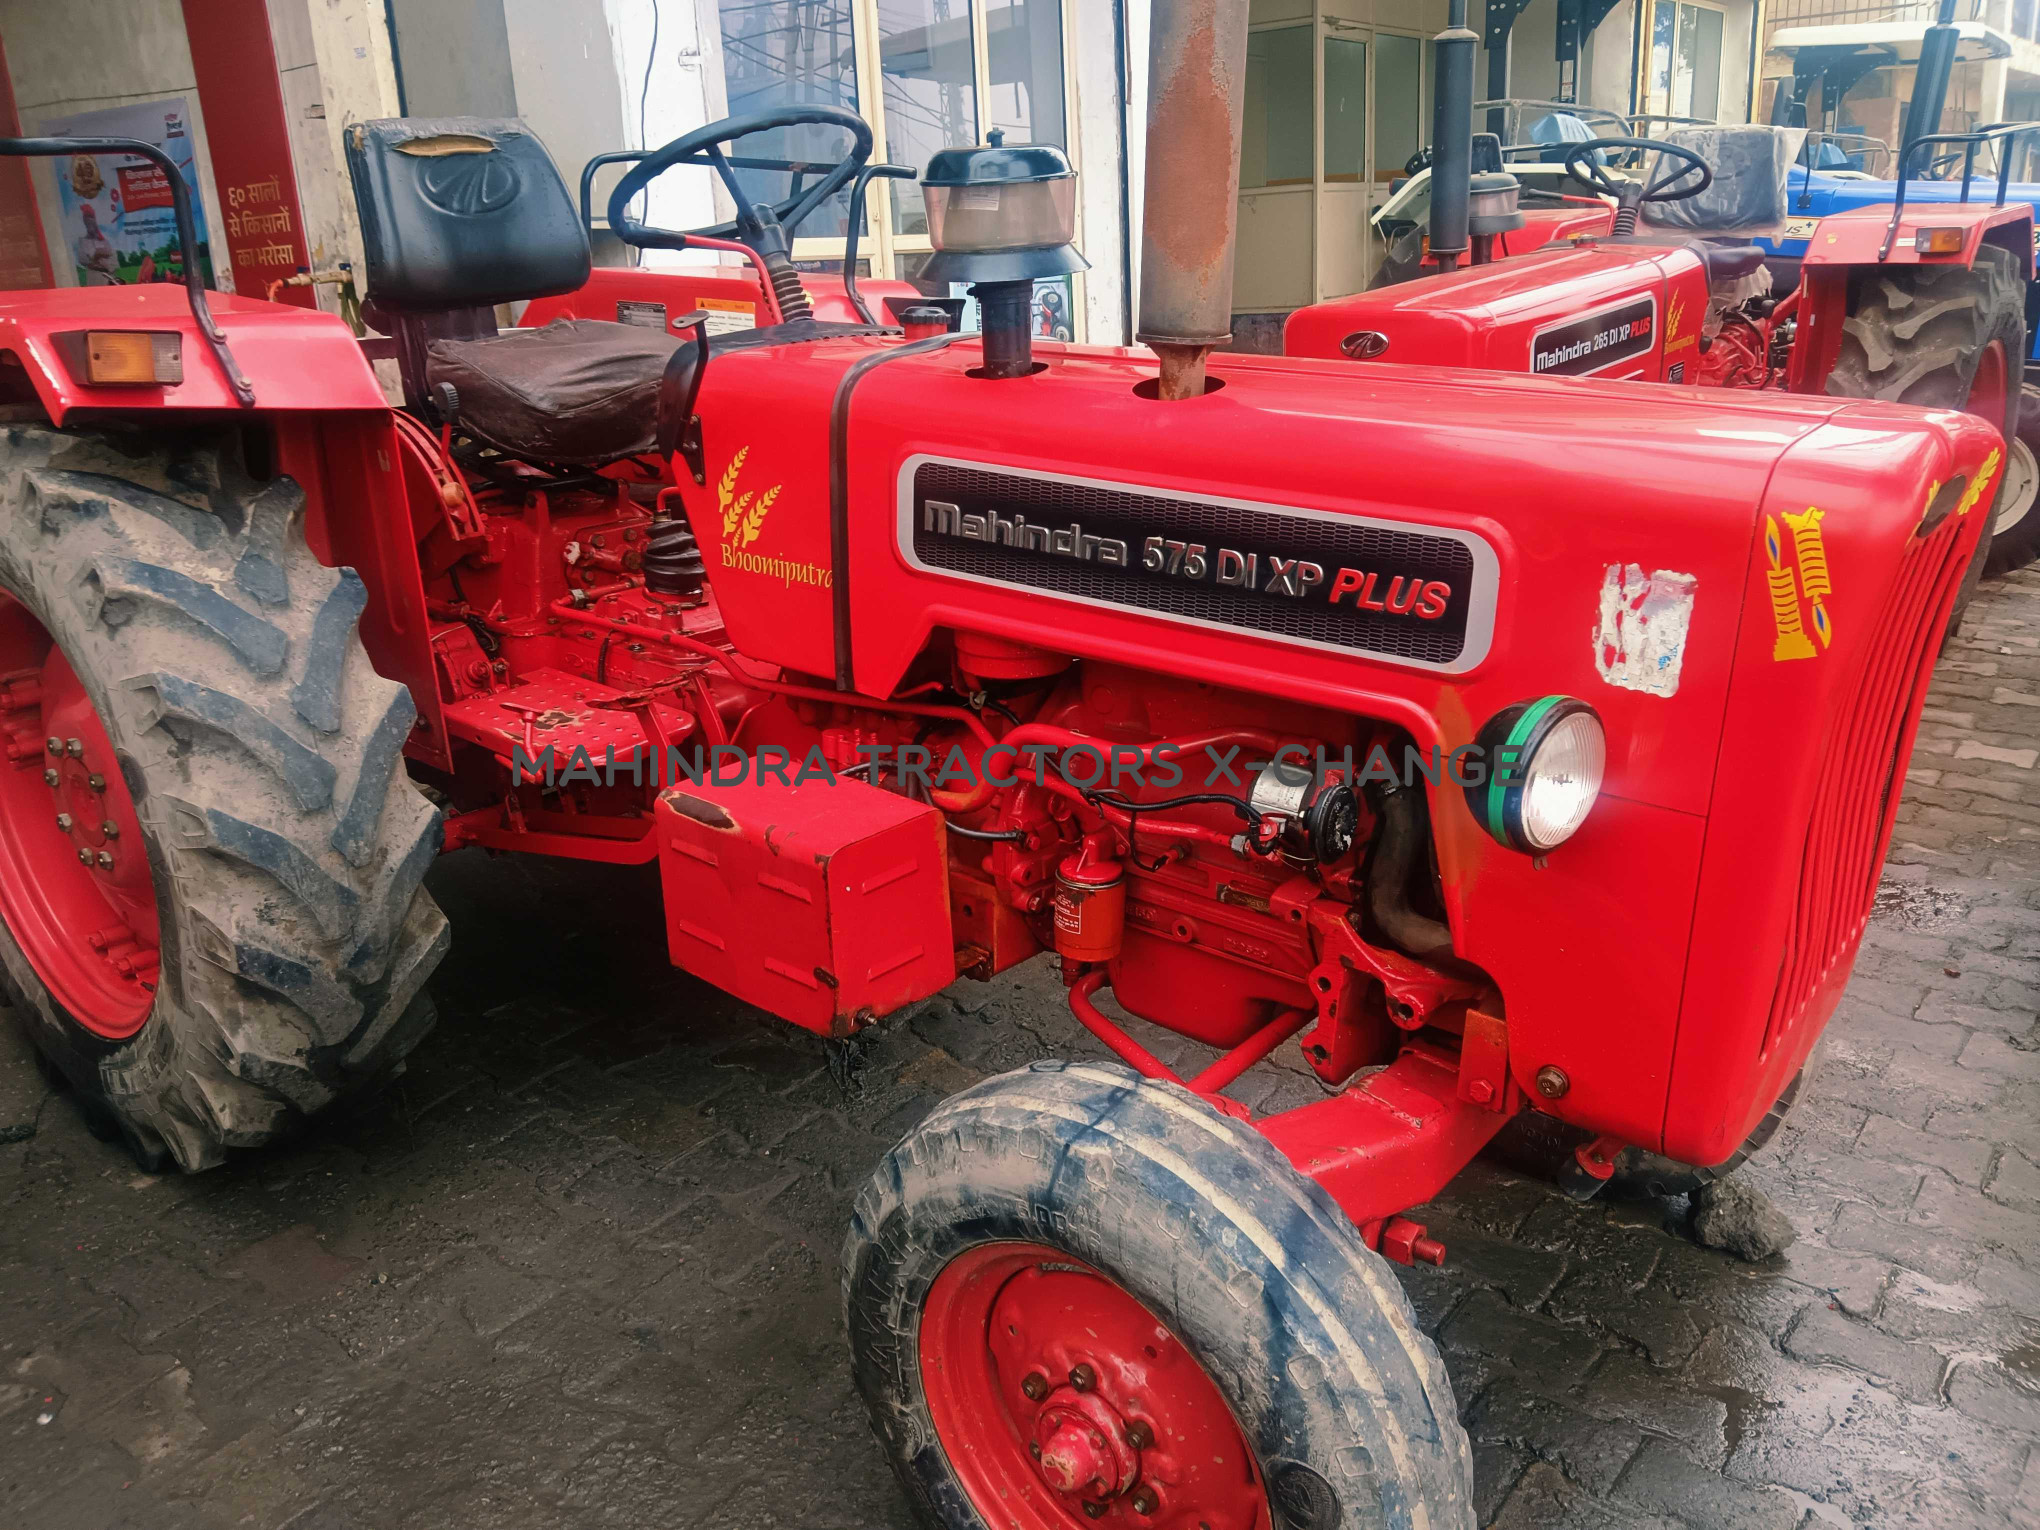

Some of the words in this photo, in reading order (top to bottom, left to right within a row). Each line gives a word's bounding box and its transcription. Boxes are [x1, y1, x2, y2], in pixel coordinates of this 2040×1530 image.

[246, 174, 281, 204] सालों
[228, 212, 242, 238] से
[242, 206, 292, 236] किसानों
[236, 248, 256, 267] का
[256, 240, 295, 266] भरोसा
[1537, 341, 1592, 372] Mahindra
[1593, 331, 1609, 352] 265
[1609, 327, 1619, 346] DI
[1619, 324, 1631, 342] XP
[1630, 317, 1651, 338] PLUS
[924, 500, 1127, 567] Mahindra
[1142, 536, 1206, 580] 575
[1216, 548, 1257, 588] DI
[1265, 558, 1324, 597] XP
[1329, 567, 1451, 619] PLUS
